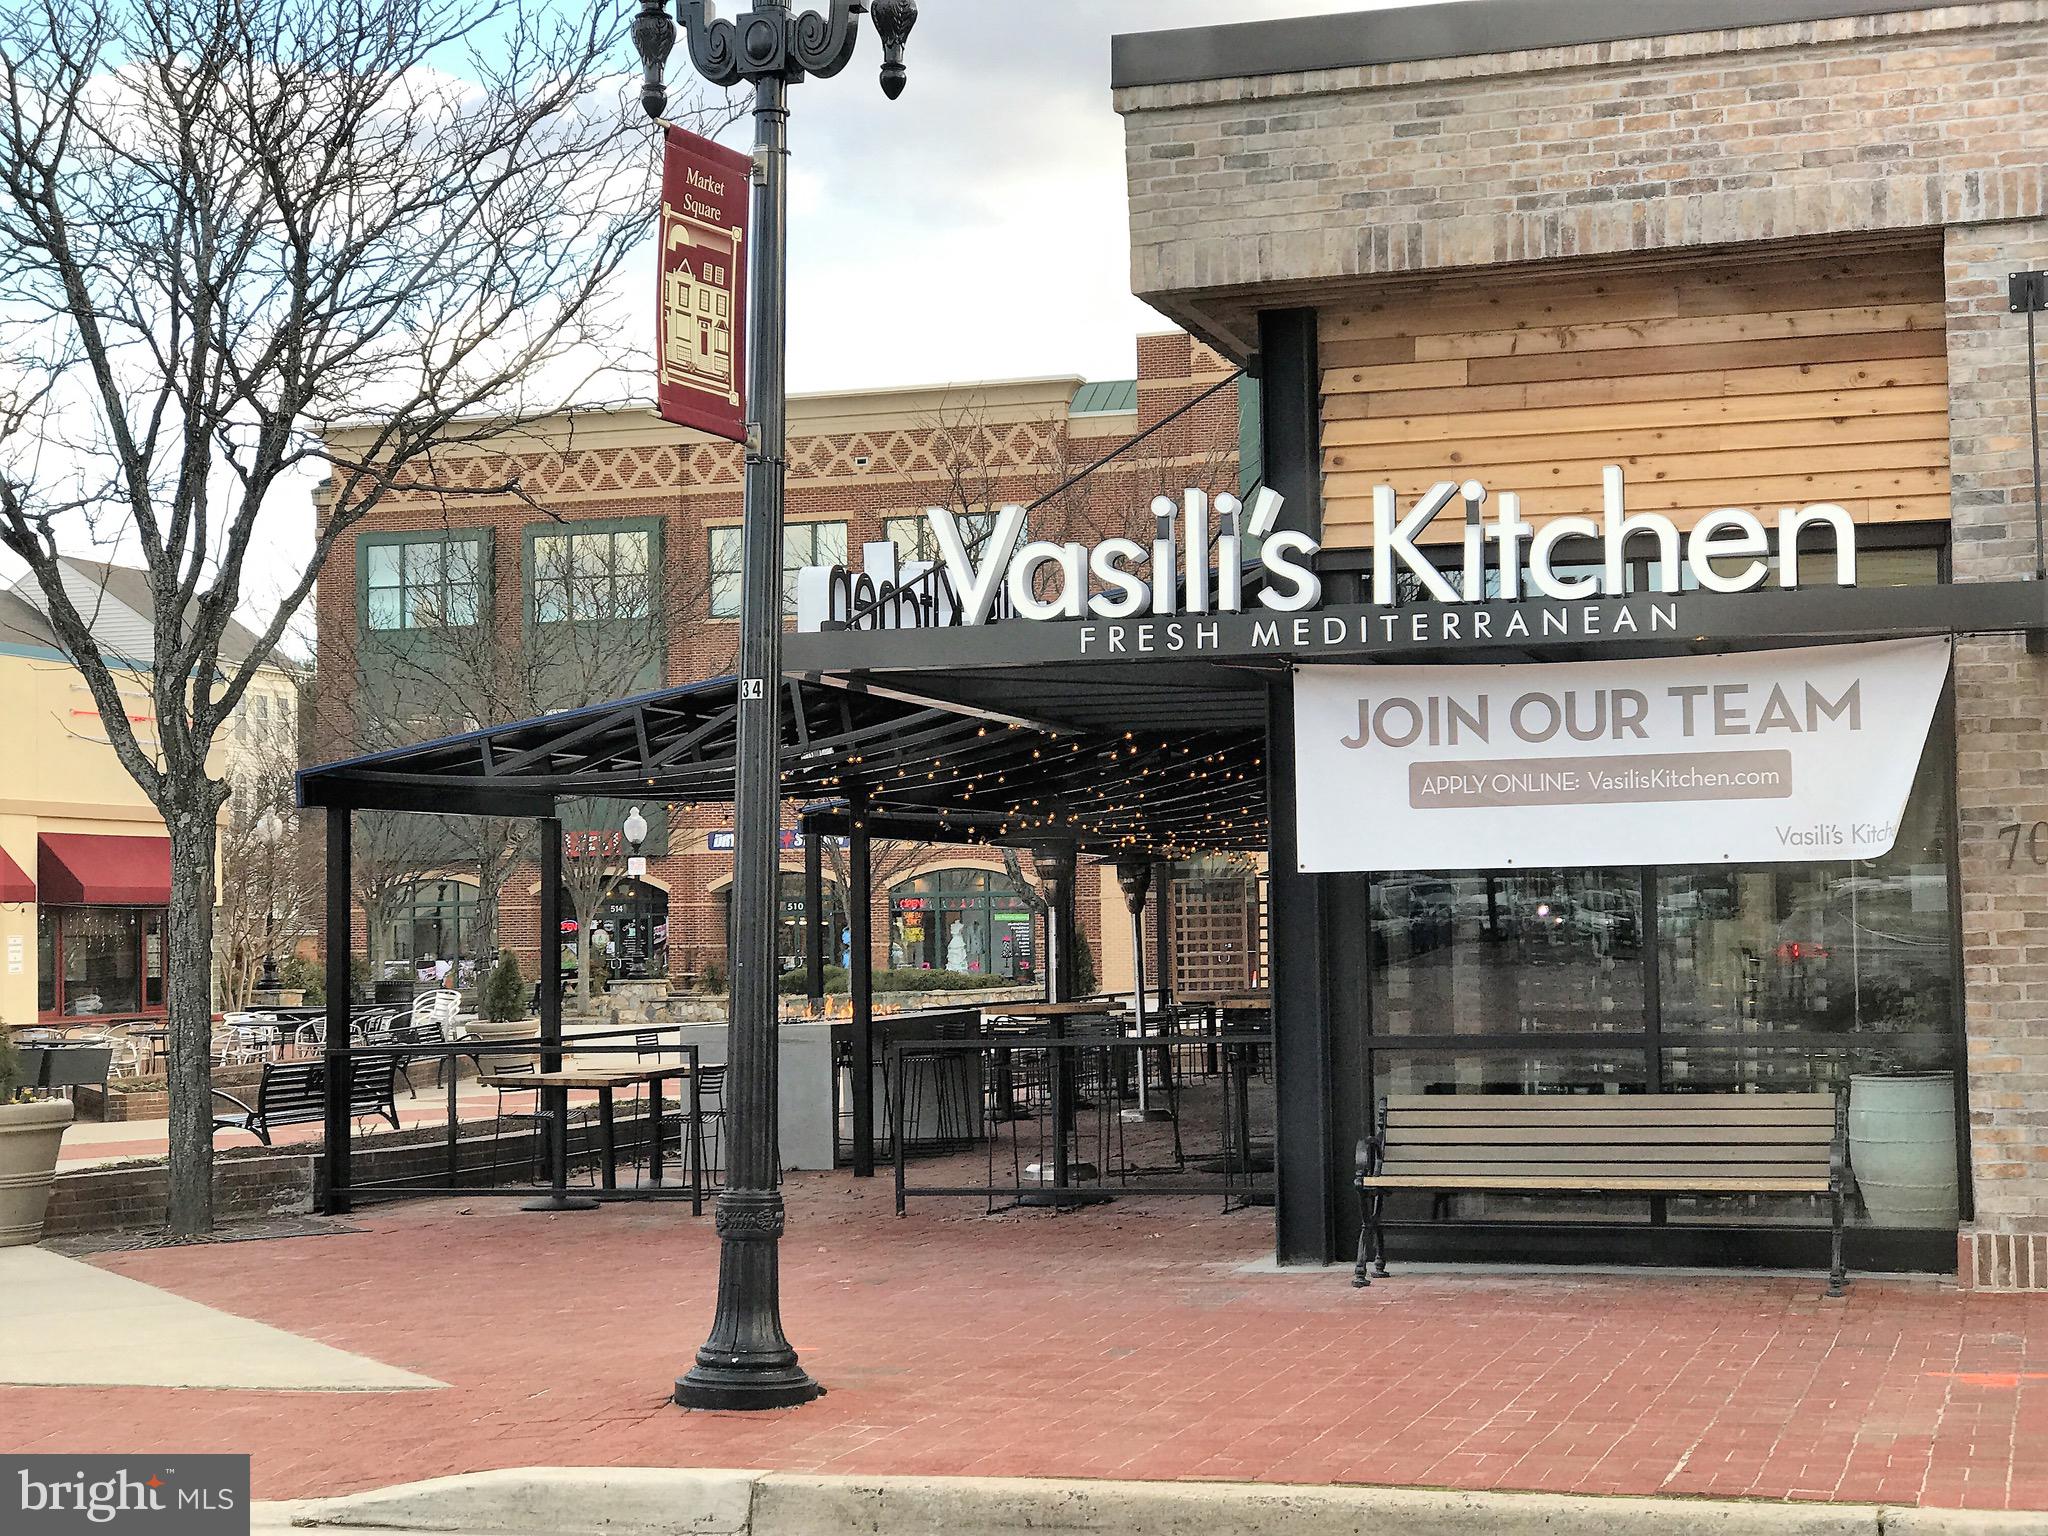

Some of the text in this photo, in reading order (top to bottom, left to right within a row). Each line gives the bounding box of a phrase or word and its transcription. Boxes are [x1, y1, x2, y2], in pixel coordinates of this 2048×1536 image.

[685, 167, 725, 197] Market
[683, 194, 722, 221] Square
[927, 465, 1858, 627] Vasili's Kitchen
[1080, 602, 1678, 653] FRESH MEDITERRANEAN
[743, 680, 762, 698] 34
[1340, 678, 1863, 749] JOIN OUR TEAM
[1421, 766, 1781, 796] APPLY ONLINE: VasilisKitchen.com
[610, 905, 624, 913] 514
[787, 902, 804, 911] 510
